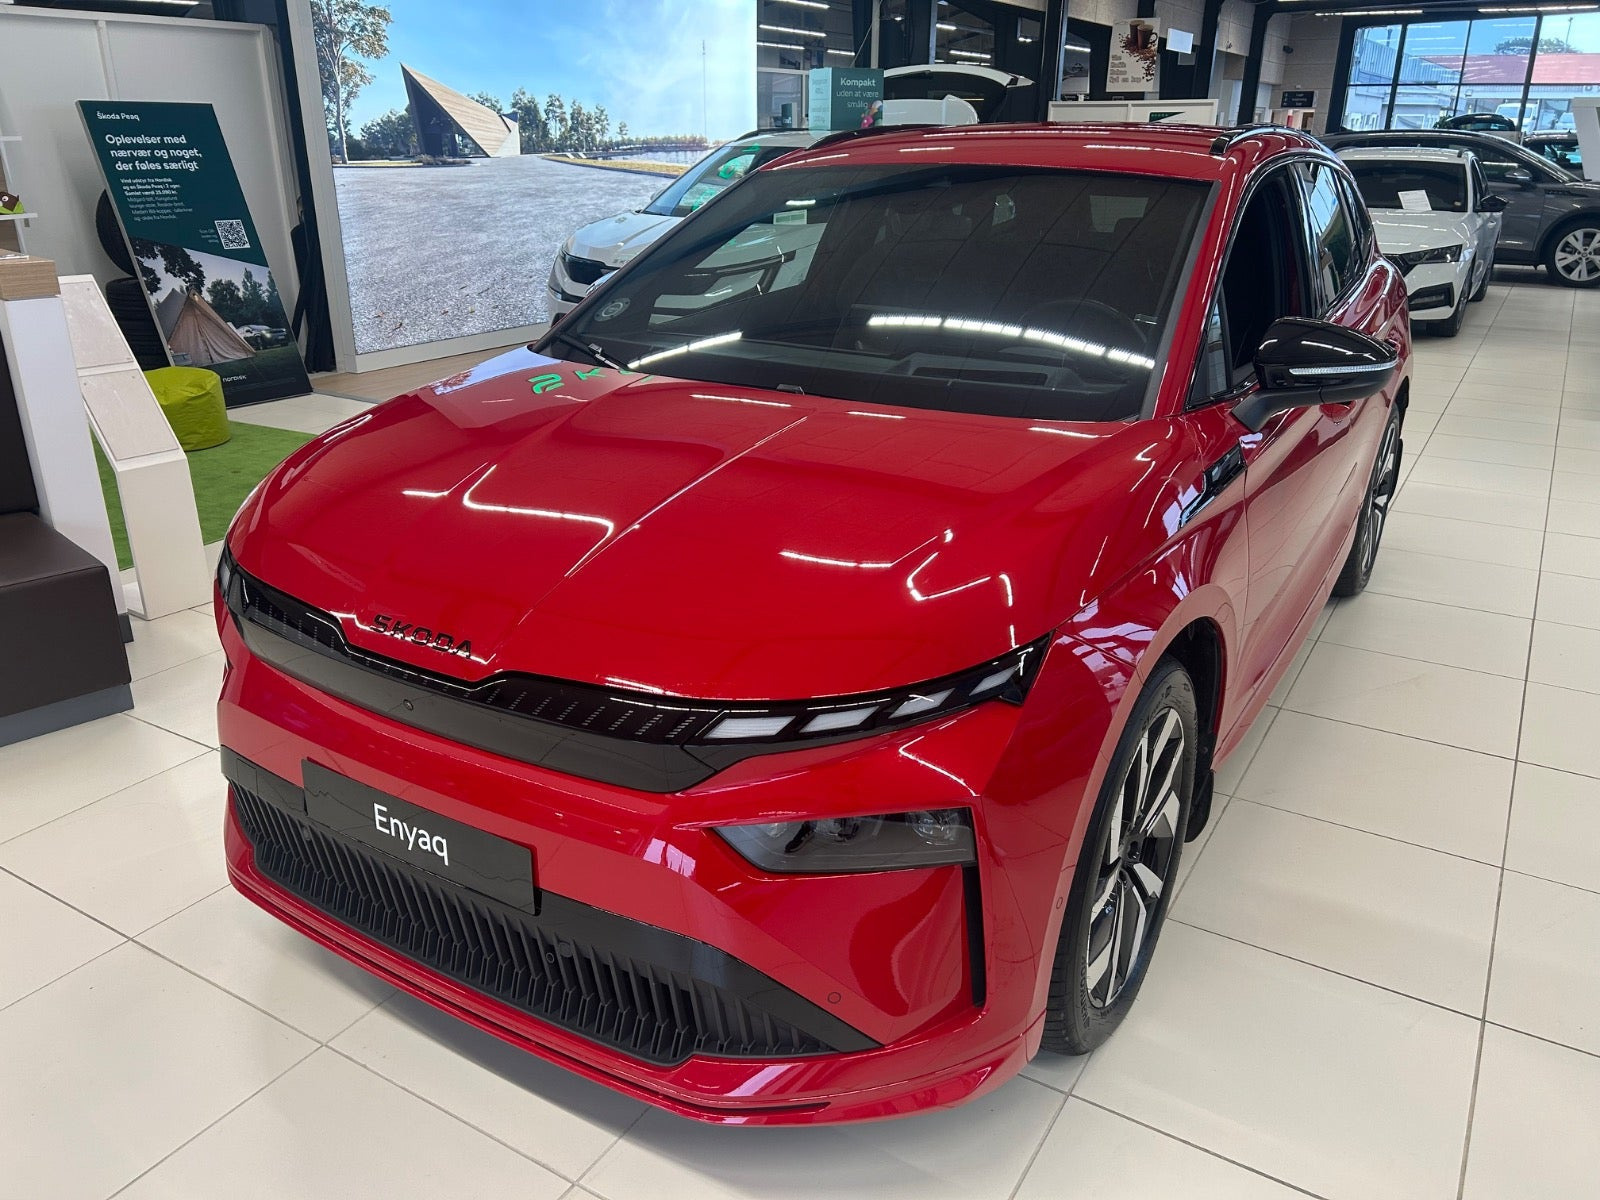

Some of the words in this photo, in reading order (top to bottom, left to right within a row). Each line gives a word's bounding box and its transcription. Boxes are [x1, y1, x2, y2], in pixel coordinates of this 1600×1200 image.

[841, 78, 876, 87] Kompakt
[97, 111, 120, 120] Škoda
[120, 113, 140, 121] Peaq
[105, 134, 161, 146] Oplevelser
[163, 134, 187, 144] med
[110, 149, 151, 157] nærvær
[154, 149, 168, 159] og
[169, 147, 203, 159] noget,
[115, 160, 133, 171] der
[134, 160, 162, 171] føles
[163, 160, 199, 172] særligt
[374, 802, 449, 867] Enyaq
